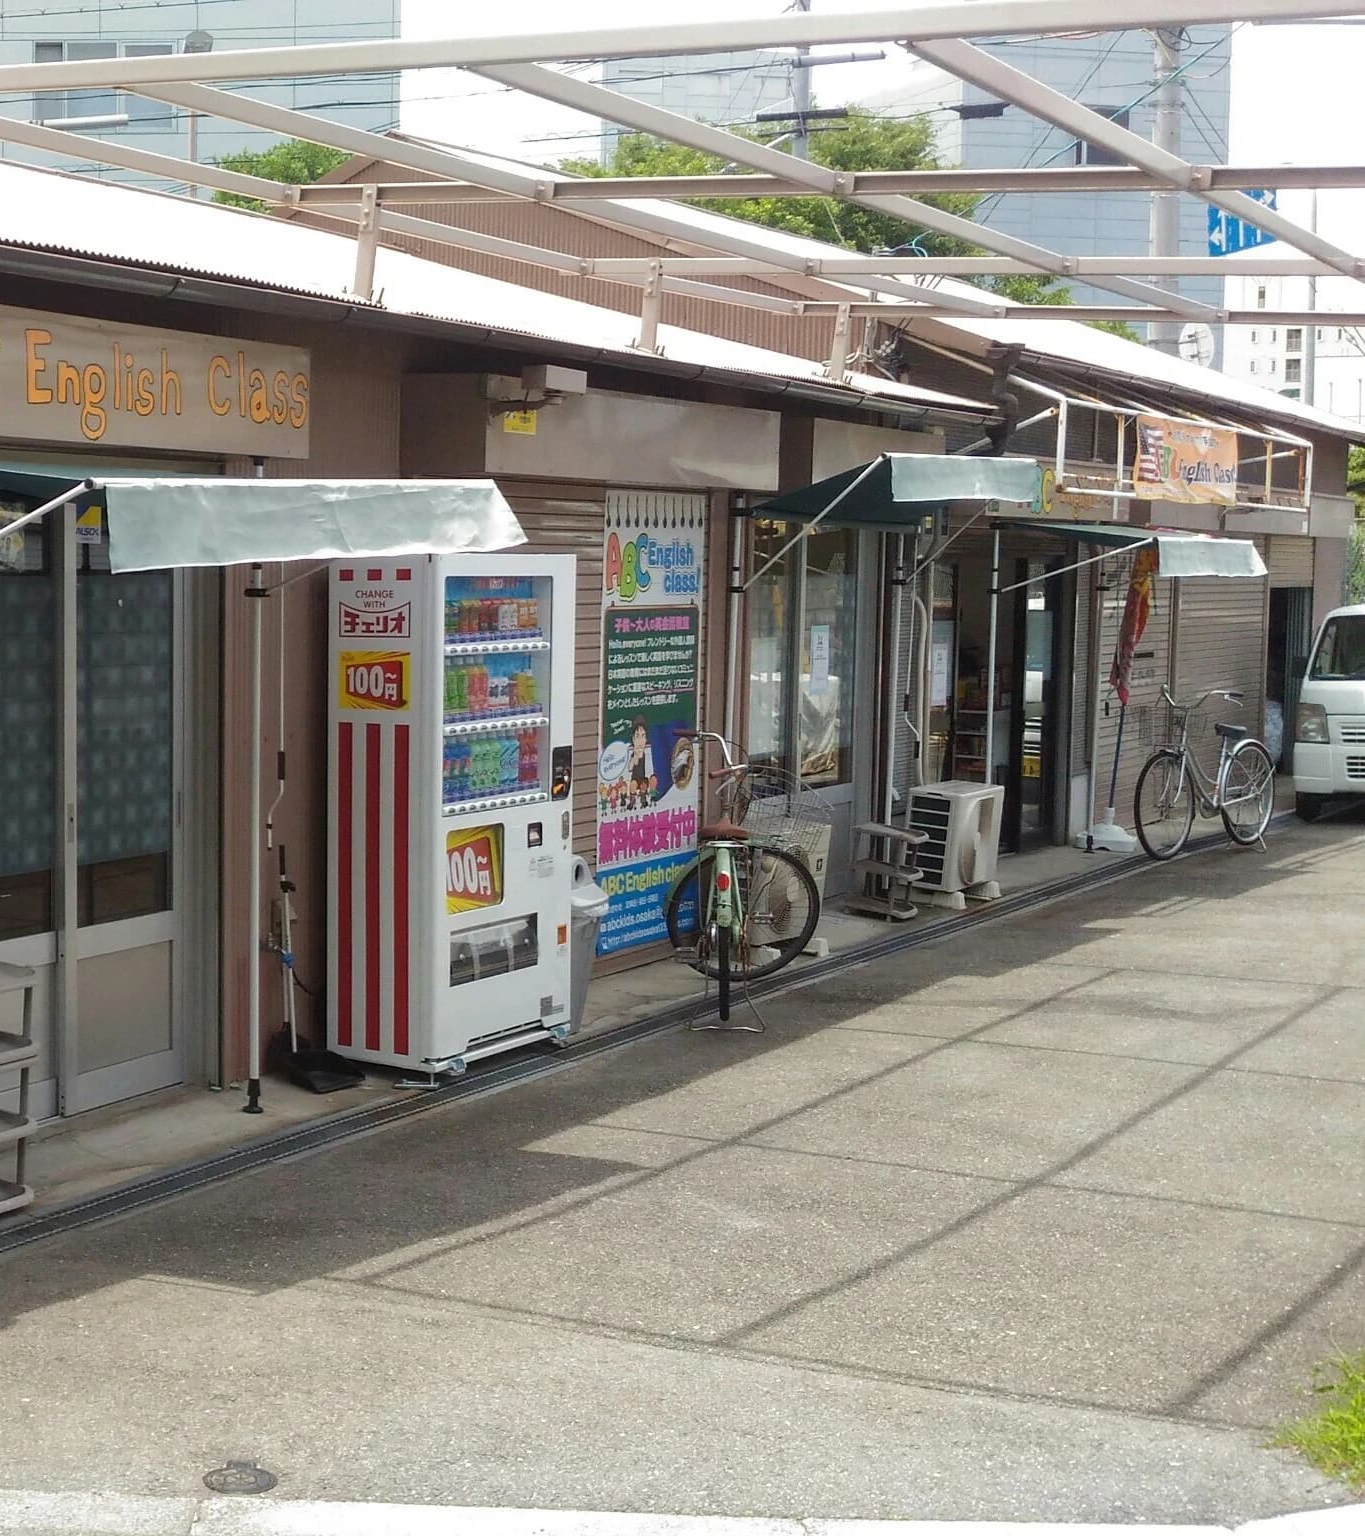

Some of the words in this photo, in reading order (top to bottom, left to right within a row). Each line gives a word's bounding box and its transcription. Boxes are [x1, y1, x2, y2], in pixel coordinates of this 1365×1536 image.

[25, 328, 182, 441] English
[207, 350, 309, 429] Class
[605, 532, 651, 601] ABC
[647, 539, 694, 570] English
[354, 589, 395, 600] CHANGE
[663, 567, 701, 595] class!
[363, 600, 386, 609] WITH
[343, 611, 406, 634] チェリオ
[601, 872, 625, 897] ABC
[625, 865, 665, 892] English
